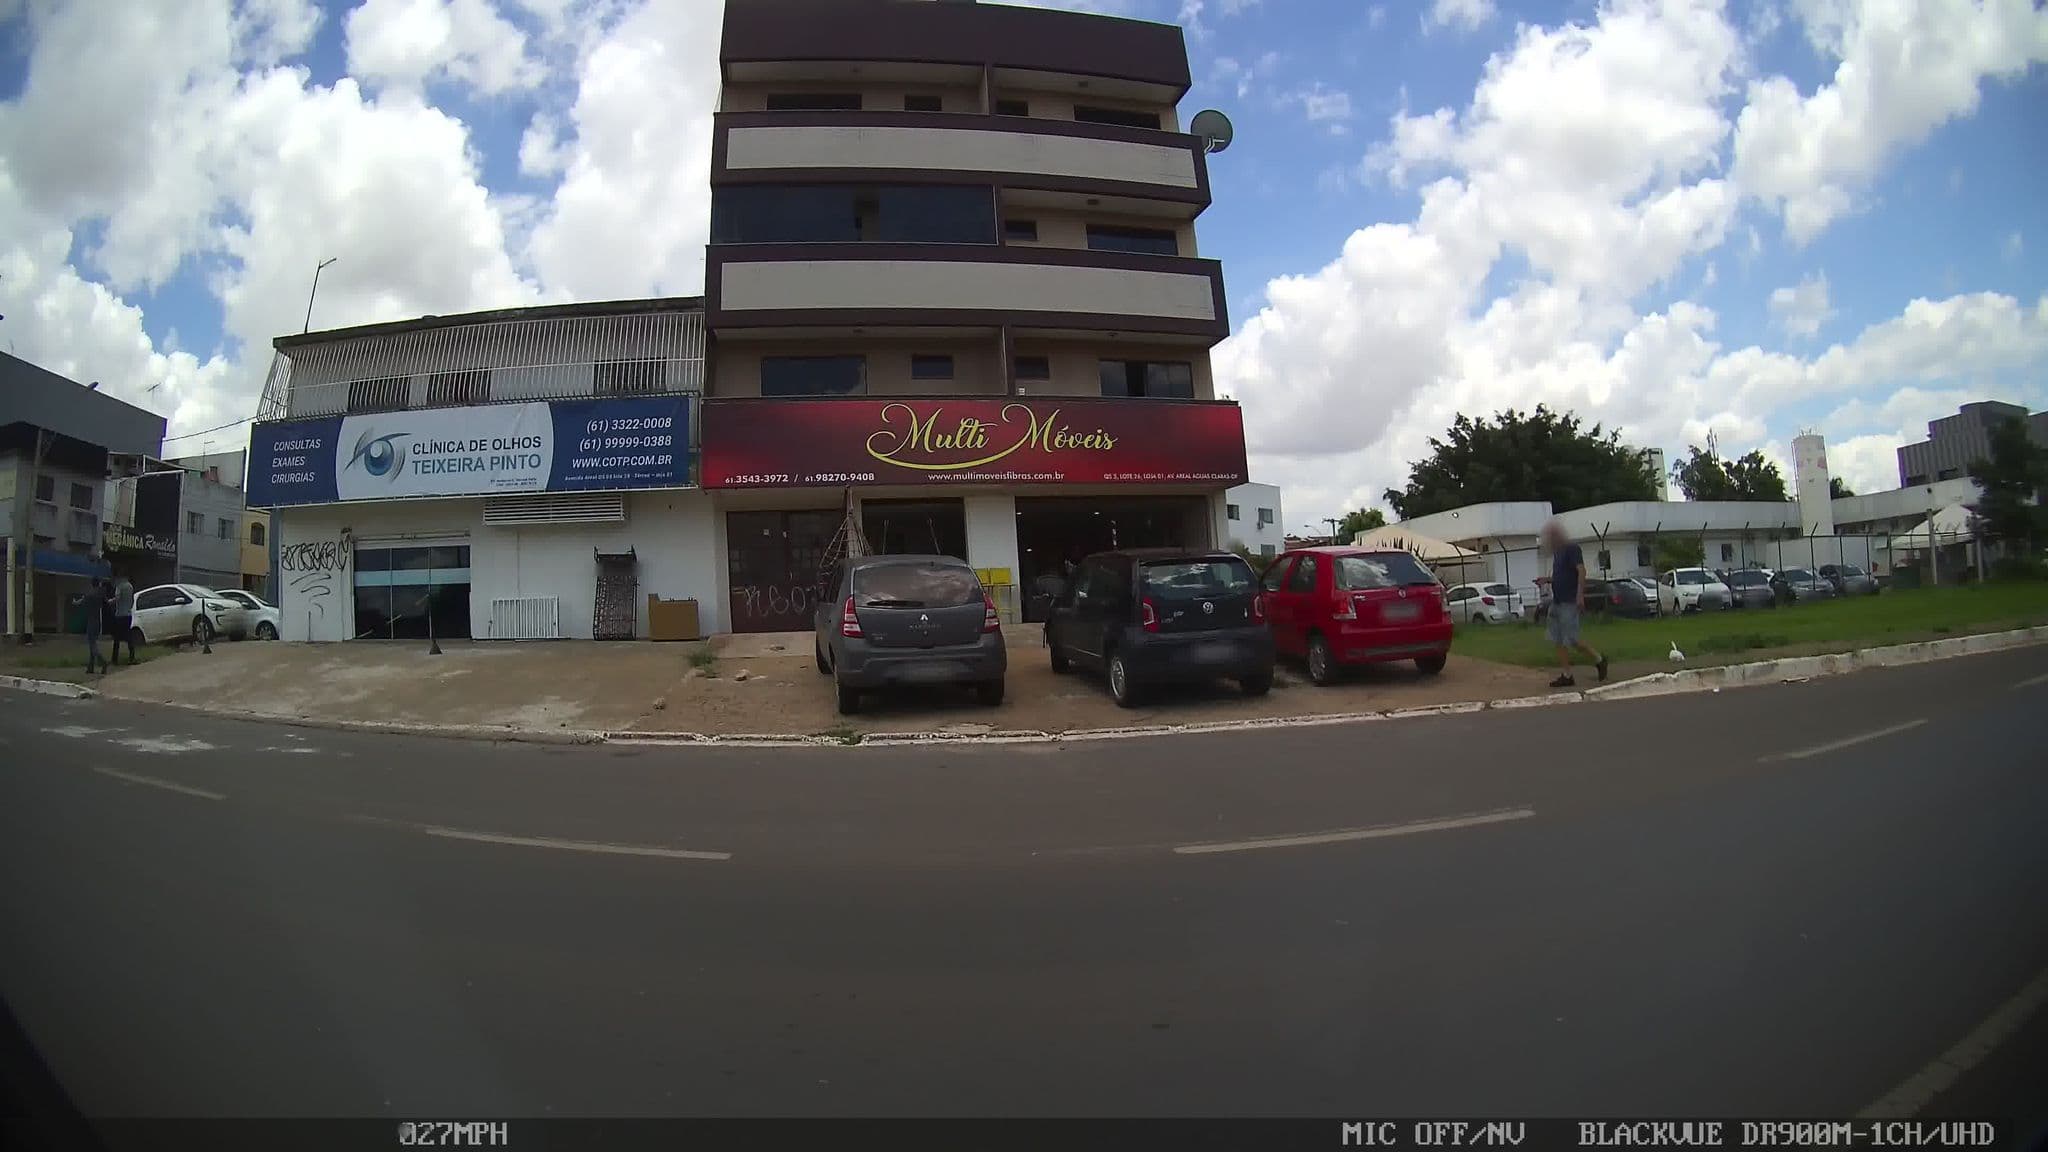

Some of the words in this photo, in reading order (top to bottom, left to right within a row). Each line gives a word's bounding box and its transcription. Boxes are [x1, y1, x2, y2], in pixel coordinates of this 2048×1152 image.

[586, 418, 609, 435] (61)
[611, 417, 672, 431] 3322-0008
[867, 403, 998, 455] Multi
[1002, 403, 1118, 453] Móveis
[273, 439, 321, 452] CONSULTAS
[412, 439, 465, 455] CLÍNICA
[469, 439, 487, 452] DE
[492, 436, 542, 451] OLHOS
[579, 437, 602, 452] (61)
[604, 435, 672, 449] 99999-0388
[272, 456, 306, 468] EXAMES
[412, 456, 486, 475] TEIXEIRA
[490, 454, 541, 471] PINTO
[572, 454, 673, 469] WWW.COTP.COM.BR
[271, 472, 315, 484] CIRURGIAS
[725, 474, 788, 484] 61.3543-3972
[805, 473, 875, 482] 61.98270-9408
[928, 471, 1065, 481] www.multimoveisfibras.com.br
